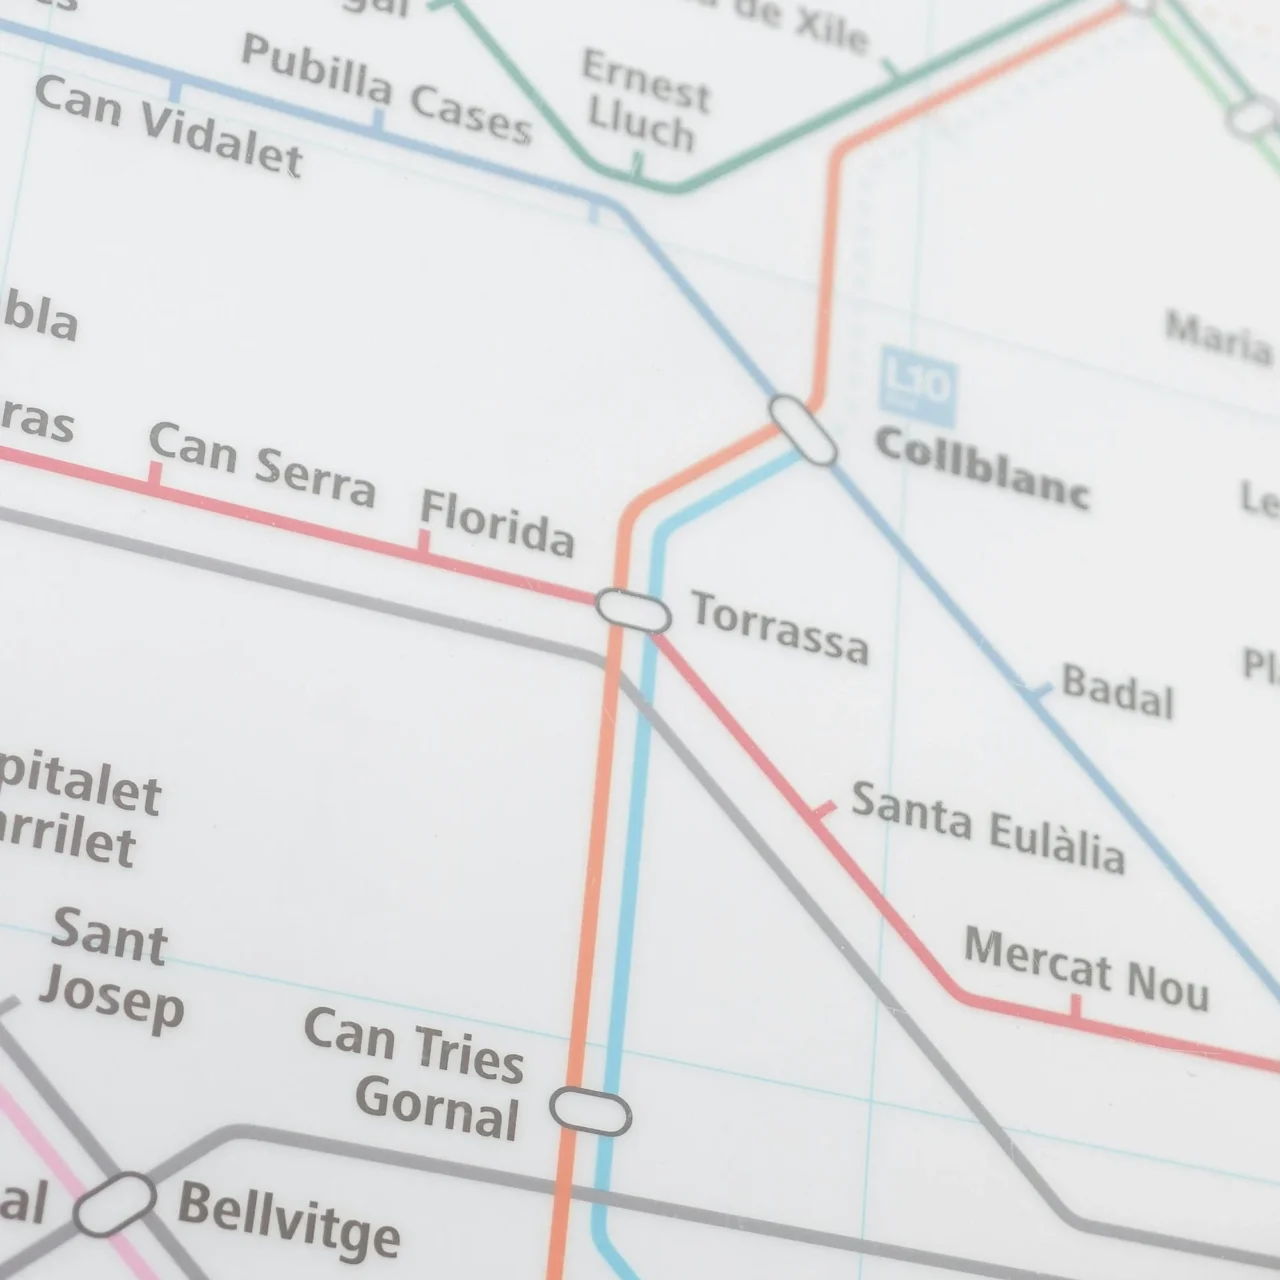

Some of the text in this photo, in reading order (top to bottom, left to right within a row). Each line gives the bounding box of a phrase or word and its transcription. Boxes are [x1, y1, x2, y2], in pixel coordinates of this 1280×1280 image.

[796, 5, 870, 56] Xile
[242, 32, 533, 147] Pubilla Cases
[582, 48, 712, 114] Ernest
[34, 73, 303, 179] Can Vidalet
[587, 96, 696, 153] Lluch
[2, 288, 80, 343] bla
[1165, 308, 1274, 367] Maria
[886, 356, 951, 404] L10
[0, 400, 75, 443] ras
[149, 421, 576, 559] Can Serra Florida
[874, 424, 1091, 512] Collblanc
[691, 590, 870, 666] Torrassa
[1061, 663, 1174, 720] Badal
[0, 749, 163, 818] pitalet
[851, 780, 1126, 875] Santa Eulàlia
[51, 906, 169, 967] Sant
[964, 925, 1210, 1013] Mercat Nou
[39, 964, 185, 1038] Josep
[304, 1006, 525, 1085] Can Tries
[355, 1075, 520, 1143] Gornal
[0, 1180, 48, 1225] al
[178, 1180, 402, 1266] Bellvitge
